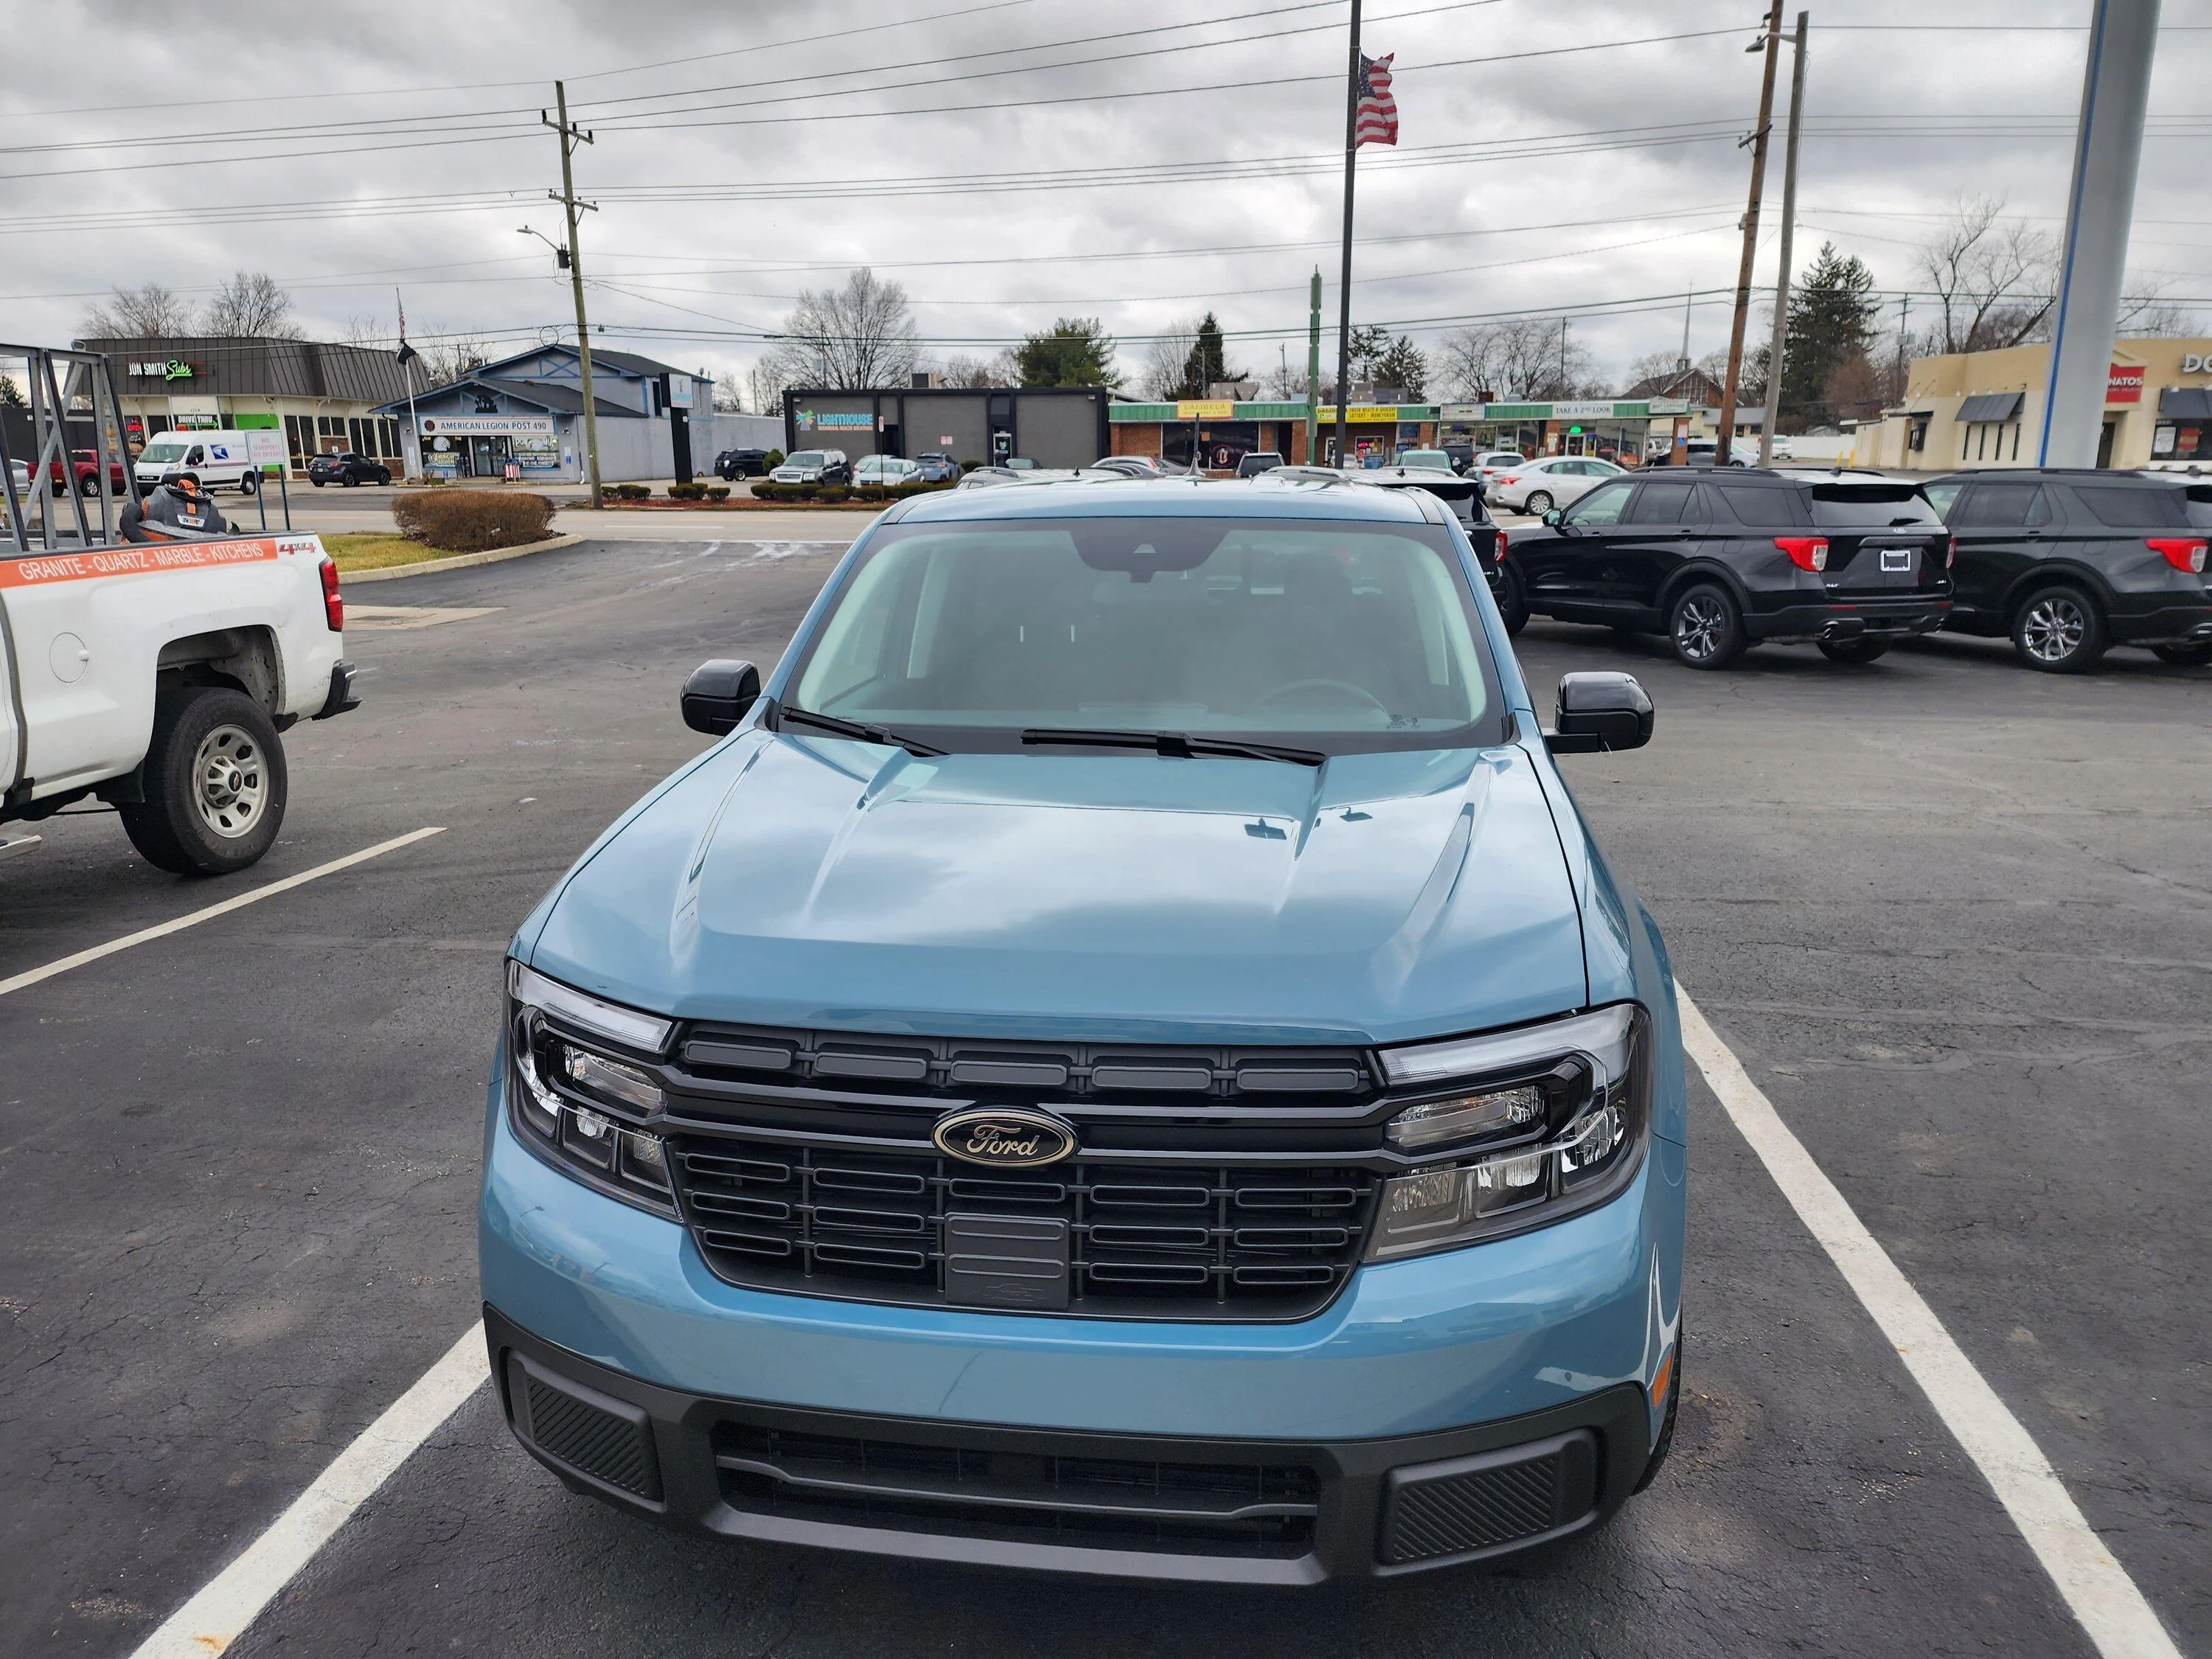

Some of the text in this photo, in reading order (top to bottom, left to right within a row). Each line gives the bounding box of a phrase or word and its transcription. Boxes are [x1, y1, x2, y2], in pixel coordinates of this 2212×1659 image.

[129, 359, 192, 380] JON SMITH Subs
[178, 415, 213, 423] DRIVE THRU
[441, 421, 546, 430] AMERICAN LEGION POST 490
[816, 414, 873, 425] LIGHTHOUSE
[18, 557, 86, 580] GRANITE
[93, 552, 150, 573] QUARTZ
[153, 546, 205, 566] MARBLE
[209, 543, 264, 560] KITCHENS
[966, 1124, 1040, 1156] Ford
